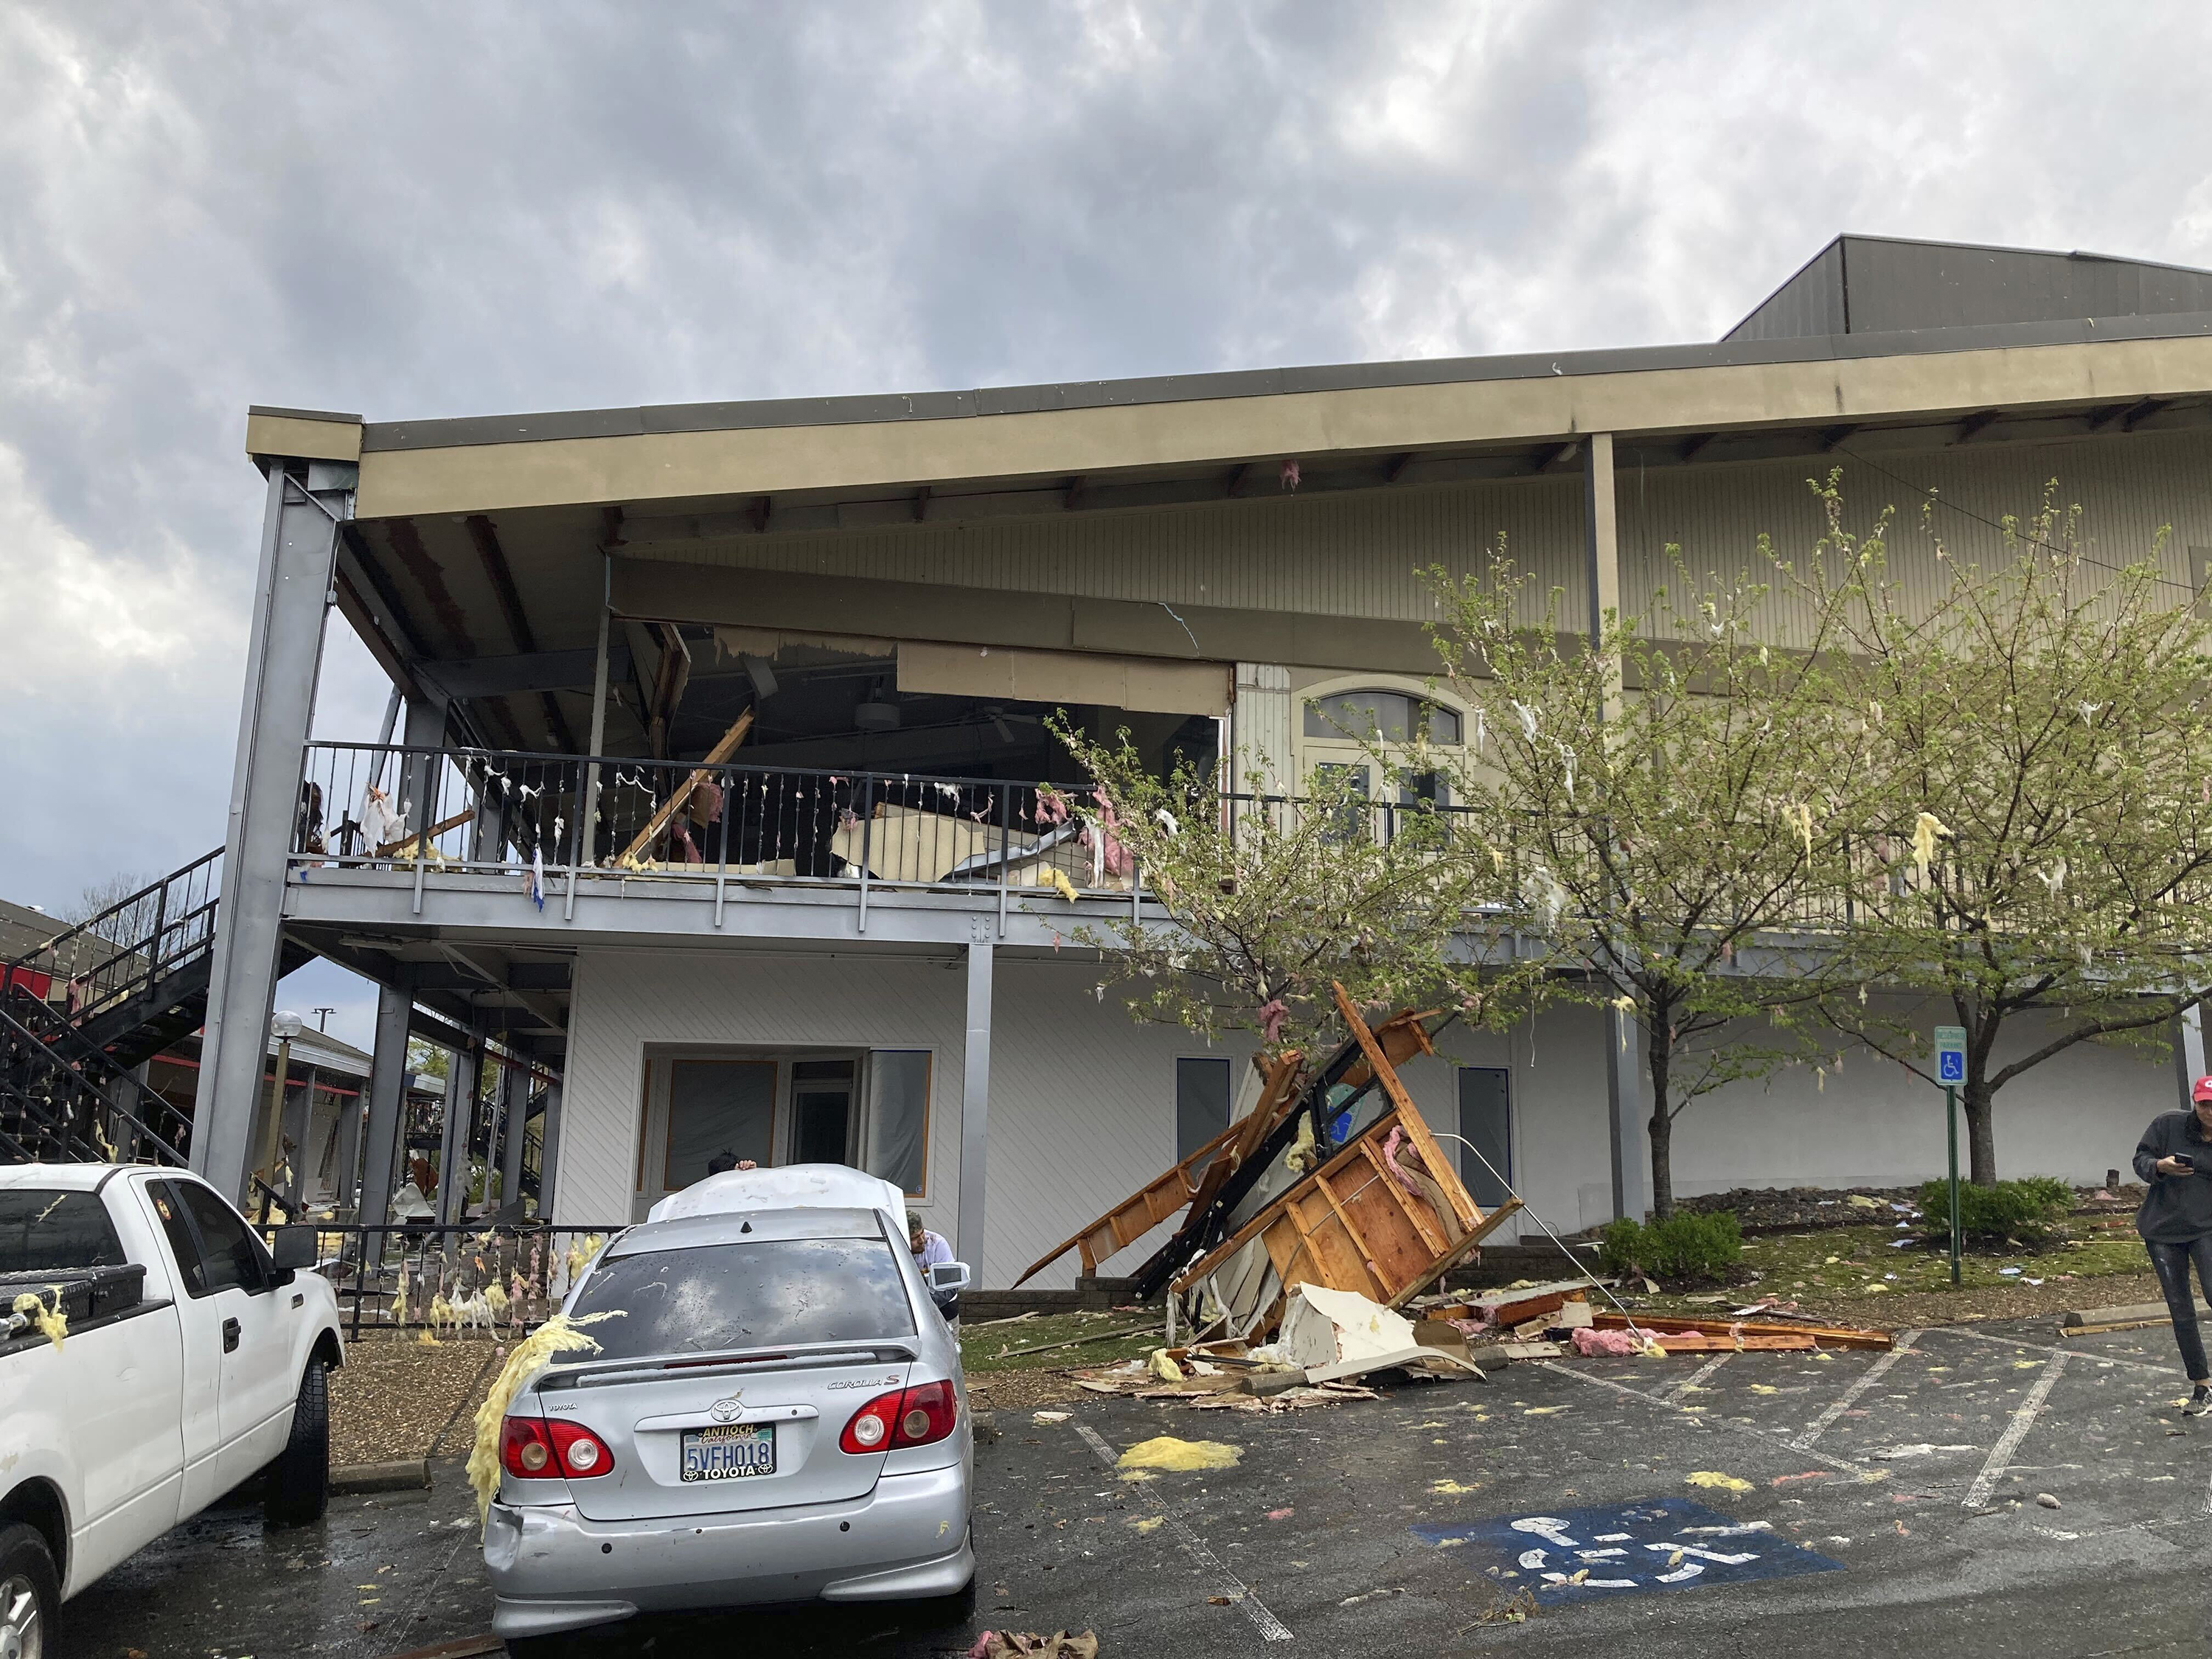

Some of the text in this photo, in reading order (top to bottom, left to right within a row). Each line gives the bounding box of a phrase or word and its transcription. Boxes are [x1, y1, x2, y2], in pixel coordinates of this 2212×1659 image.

[827, 1374, 900, 1390] COROLLA S
[549, 1402, 578, 1411] TOYOTA
[703, 1425, 754, 1437] ANTIOCH
[687, 1442, 769, 1472] 5VFH018
[703, 1465, 755, 1480] TOYOTA
